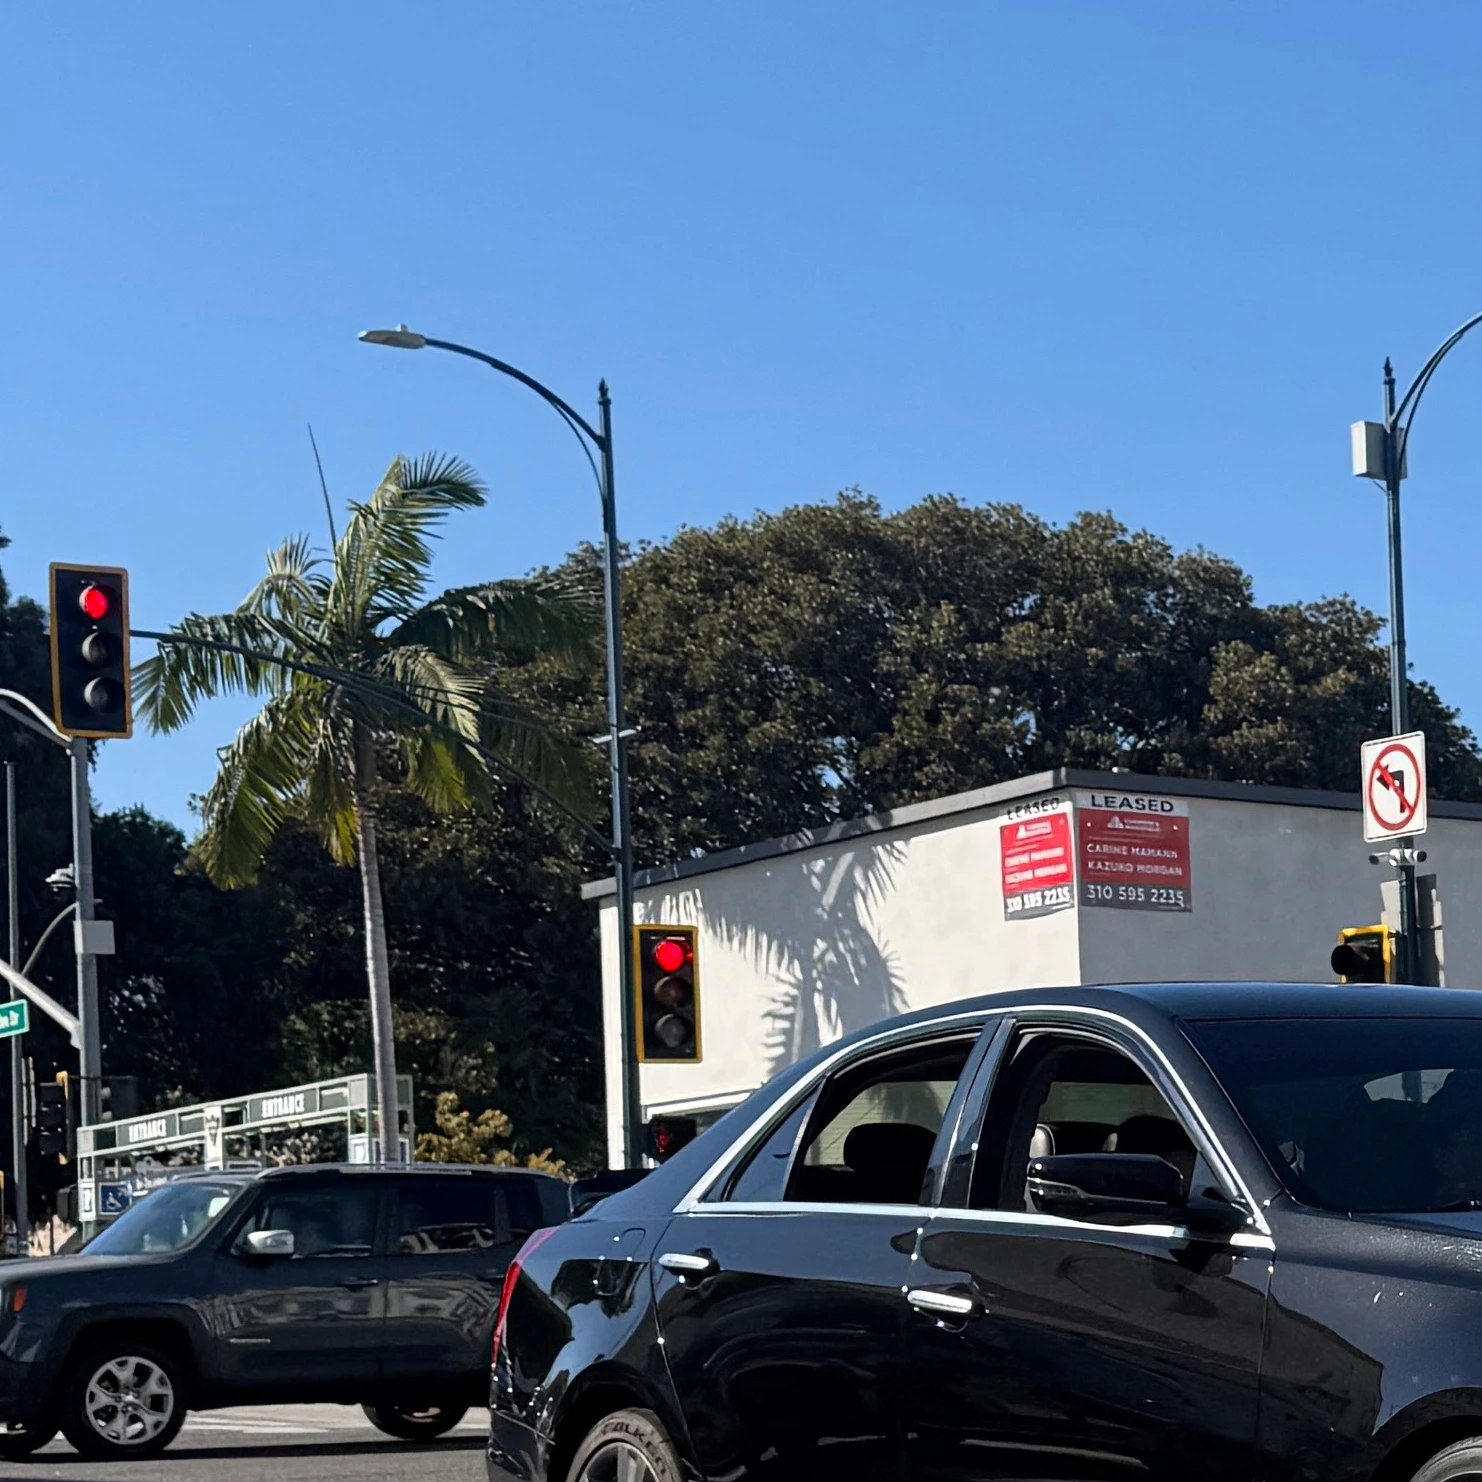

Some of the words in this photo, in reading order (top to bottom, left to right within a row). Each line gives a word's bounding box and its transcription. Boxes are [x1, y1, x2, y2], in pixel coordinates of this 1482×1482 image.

[1091, 793, 1174, 813] LEASED
[1087, 884, 1113, 899] 310
[1119, 886, 1145, 901] 595
[1150, 889, 1184, 905] 2235
[262, 1094, 305, 1118] ENTRANCE
[128, 1119, 167, 1142] ENTRANCE
